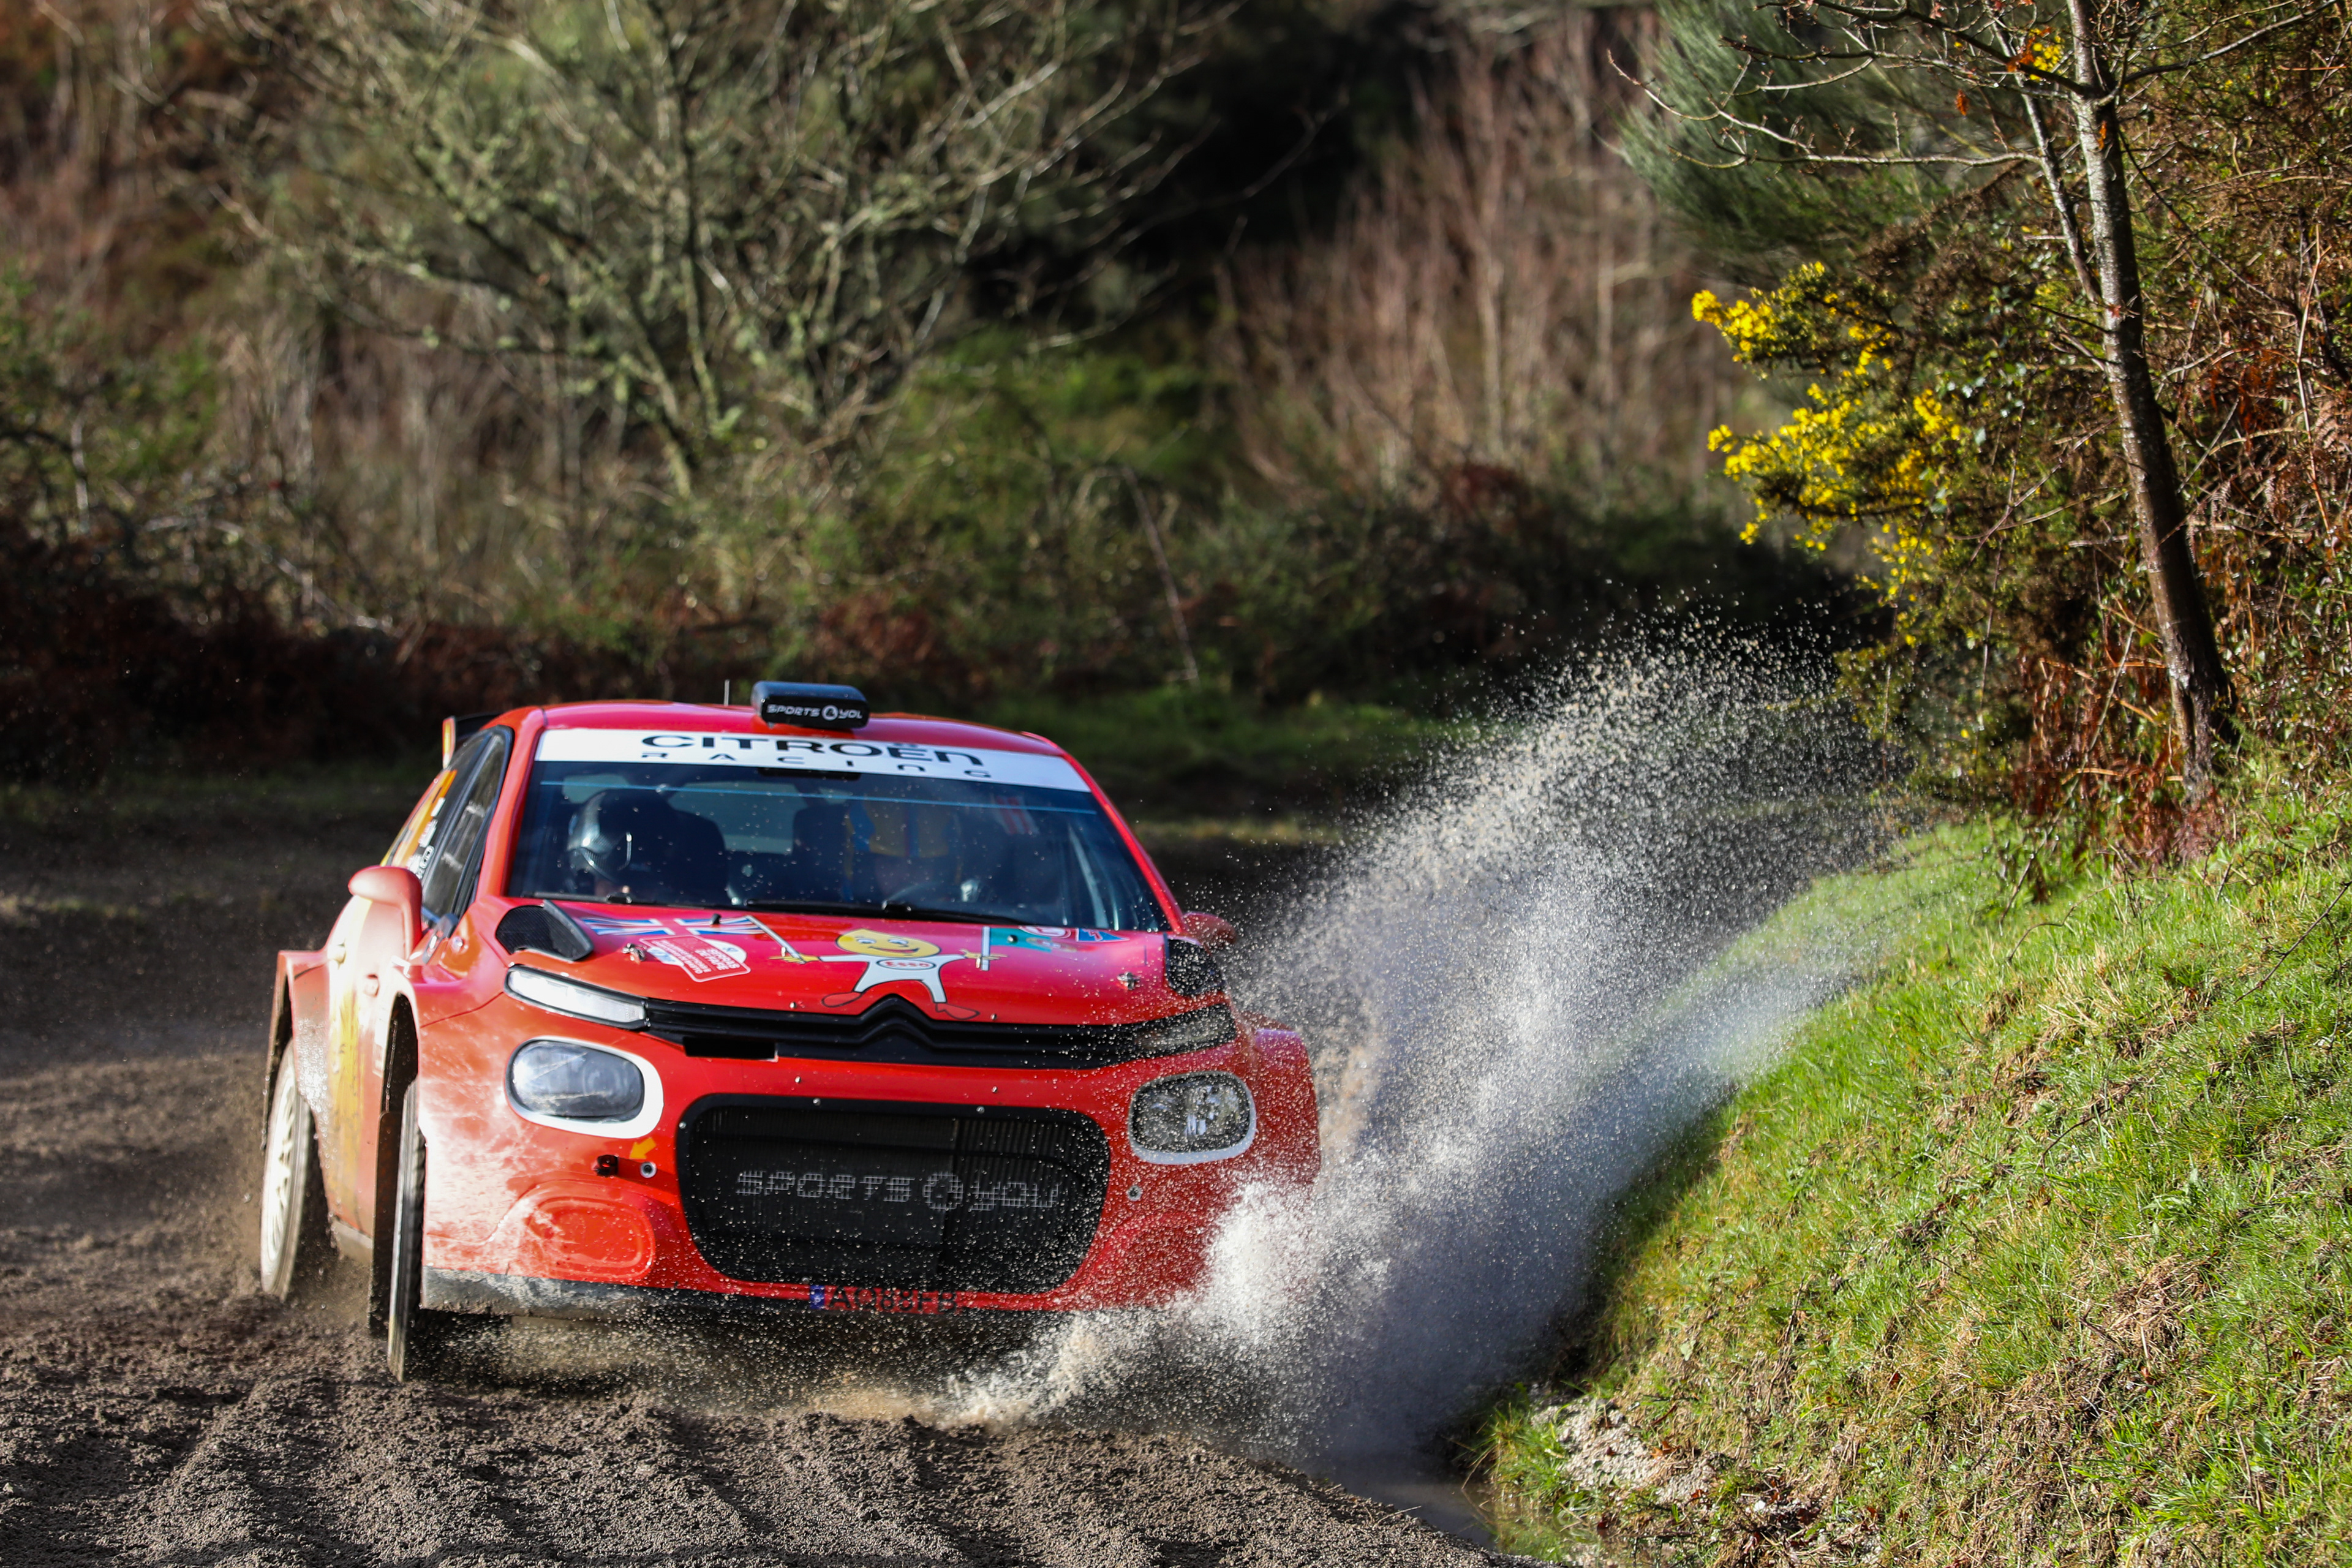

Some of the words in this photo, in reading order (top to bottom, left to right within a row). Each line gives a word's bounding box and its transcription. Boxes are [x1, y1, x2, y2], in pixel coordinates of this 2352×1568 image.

[767, 704, 821, 717] SPORTS
[641, 752, 991, 778] RACING
[704, 956, 729, 971] FAFE
[705, 948, 742, 969] SERRAS
[736, 1170, 916, 1203] SPORTS
